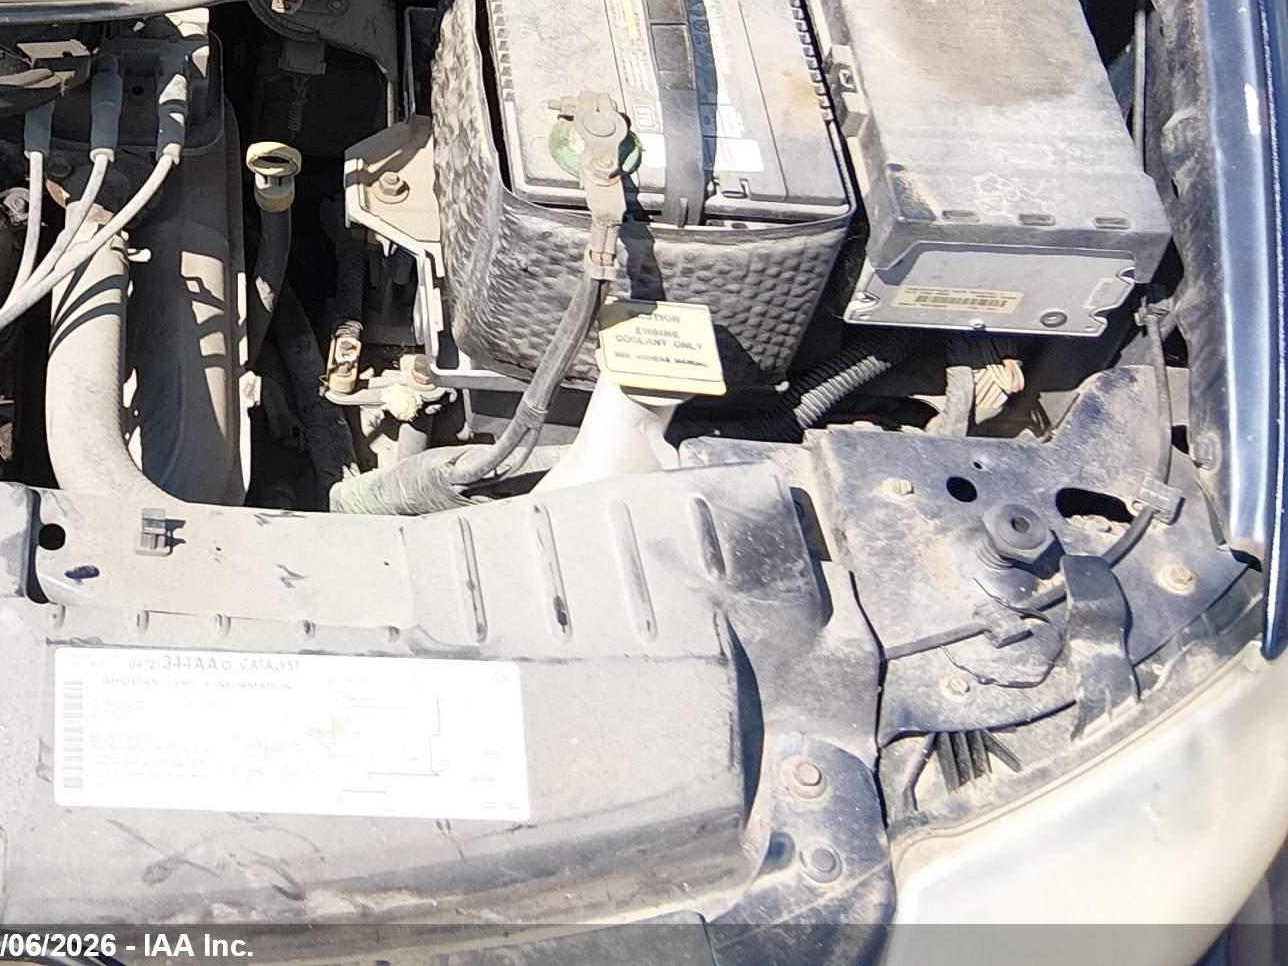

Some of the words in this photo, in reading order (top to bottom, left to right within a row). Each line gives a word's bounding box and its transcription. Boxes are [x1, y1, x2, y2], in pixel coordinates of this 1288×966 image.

[635, 326, 680, 339] ENGINE
[615, 334, 667, 347] COOLANT
[673, 340, 703, 351] ONLY
[101, 677, 162, 688] IMPORTAN
